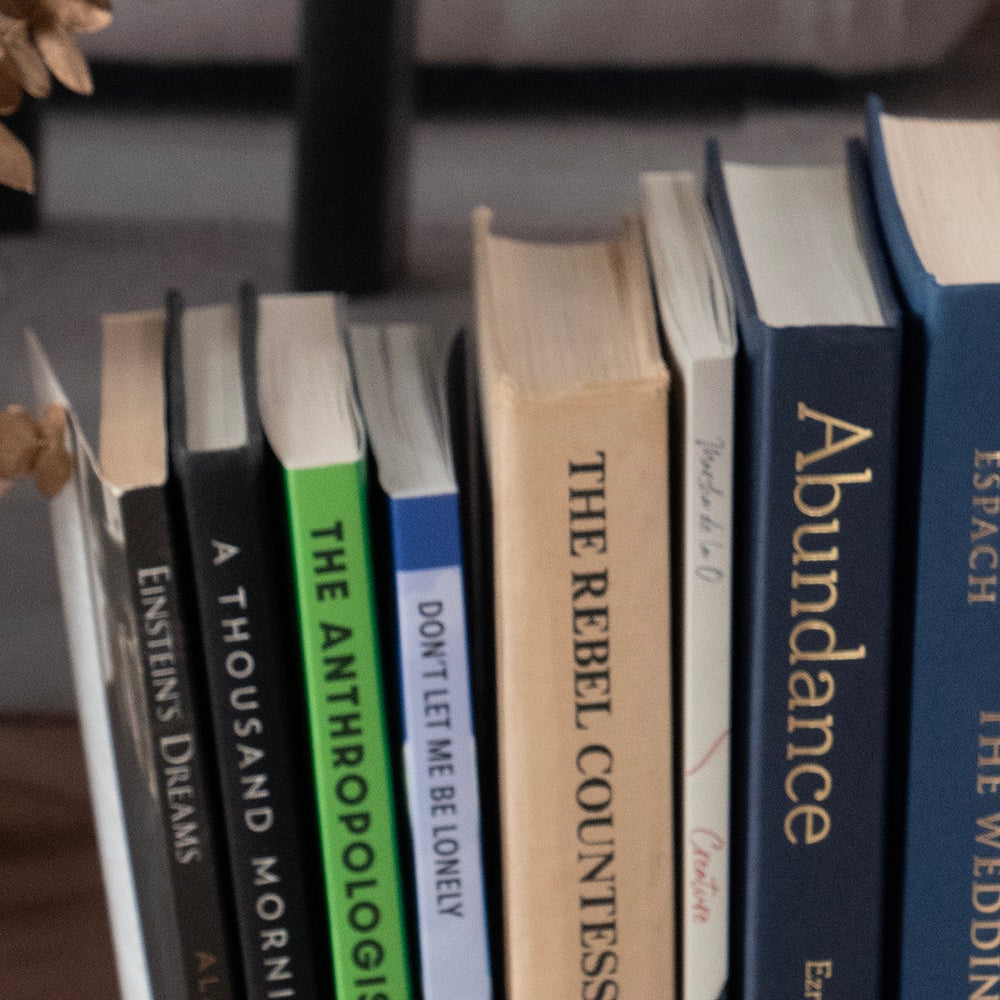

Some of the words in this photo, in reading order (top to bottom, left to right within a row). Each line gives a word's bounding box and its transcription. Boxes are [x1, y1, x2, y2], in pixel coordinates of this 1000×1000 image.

[568, 450, 607, 558] THE
[966, 448, 1000, 605] ESPACH
[211, 538, 241, 566] A
[309, 520, 351, 603] THE
[418, 600, 448, 680] DON'T
[571, 567, 613, 731] REBEL
[783, 403, 874, 846] Abundance
[217, 586, 276, 835] THOUSAND
[423, 688, 452, 729] LET
[159, 732, 200, 865] DREAMS
[428, 738, 456, 778] ME
[429, 785, 458, 819] BE
[432, 824, 464, 917] LONELY
